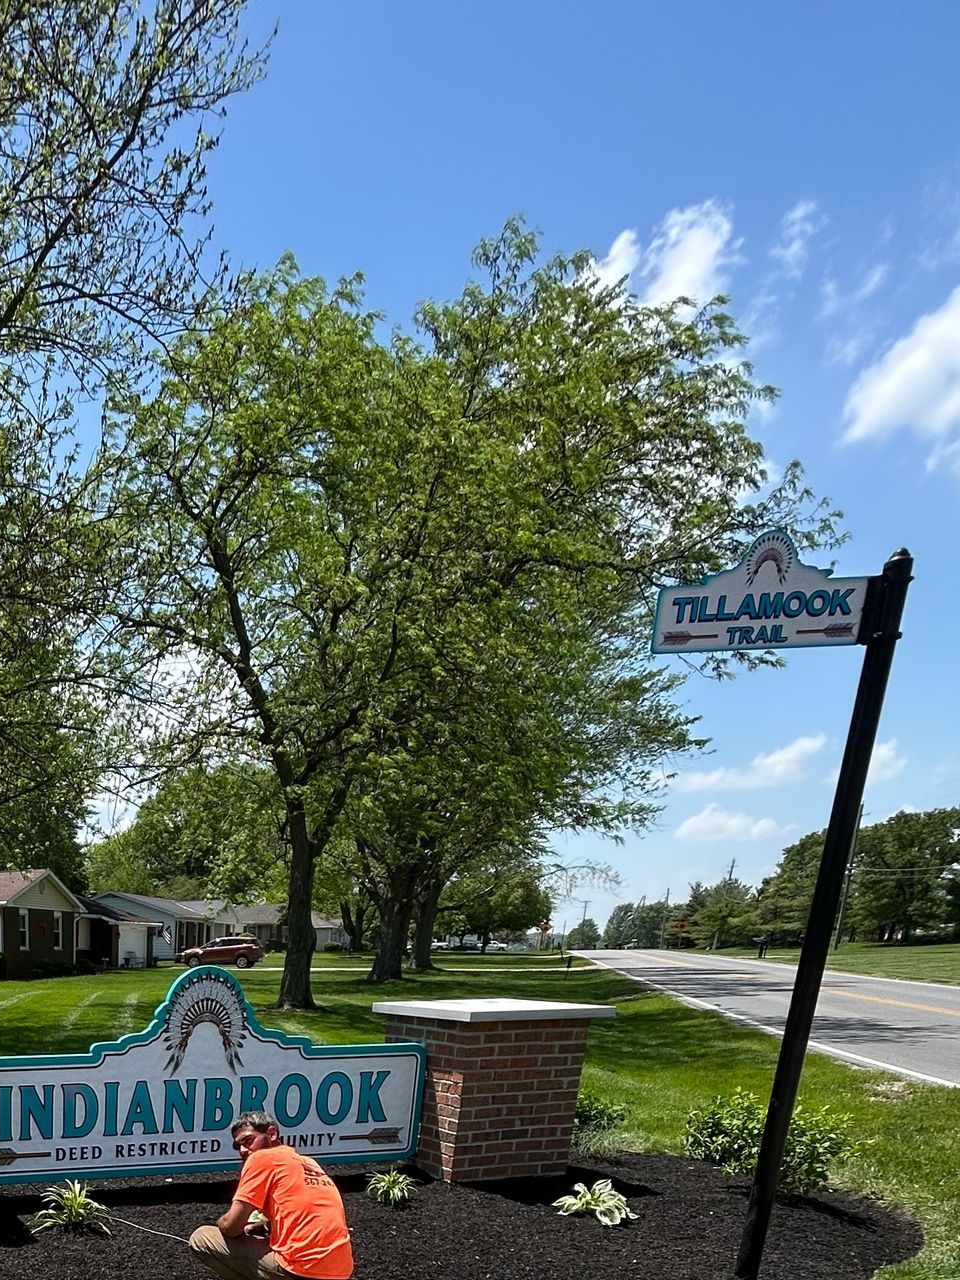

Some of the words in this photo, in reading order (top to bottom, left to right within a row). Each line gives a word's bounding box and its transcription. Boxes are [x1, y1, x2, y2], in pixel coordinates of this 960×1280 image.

[672, 588, 855, 624] TILLAMOOK
[726, 624, 788, 645] TRAIL
[55, 1145, 103, 1161] DEED
[115, 1139, 221, 1158] RESTRICTED
